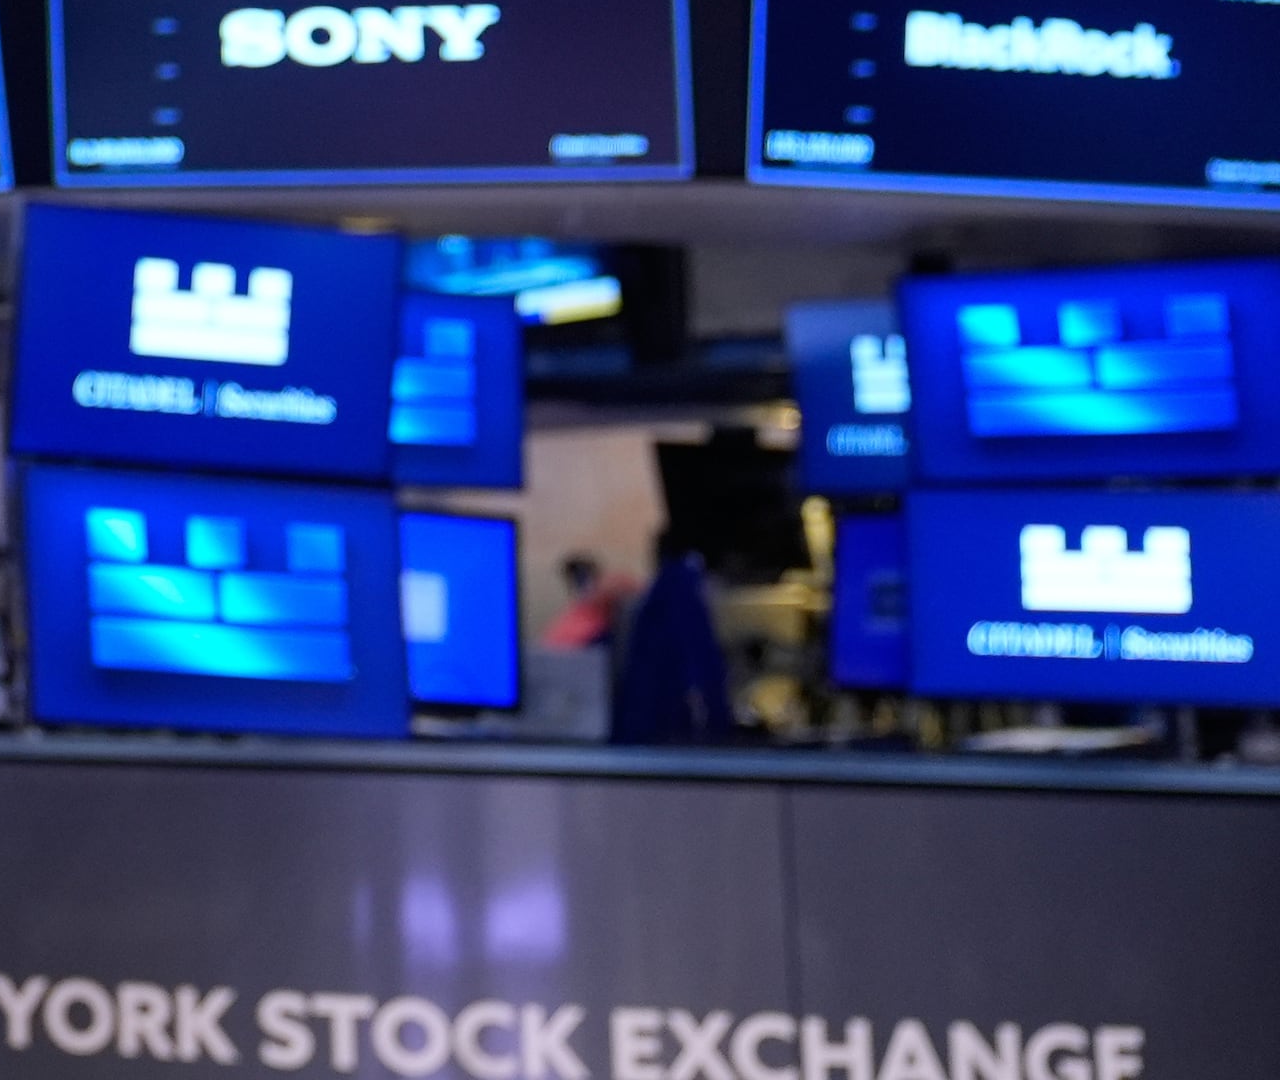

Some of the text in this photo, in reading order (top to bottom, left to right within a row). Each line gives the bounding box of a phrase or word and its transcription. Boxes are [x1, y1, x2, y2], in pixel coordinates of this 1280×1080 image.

[219, 4, 500, 67] SONY
[255, 987, 591, 1080] STOCK
[610, 1007, 1146, 1080] EXCHANGE
